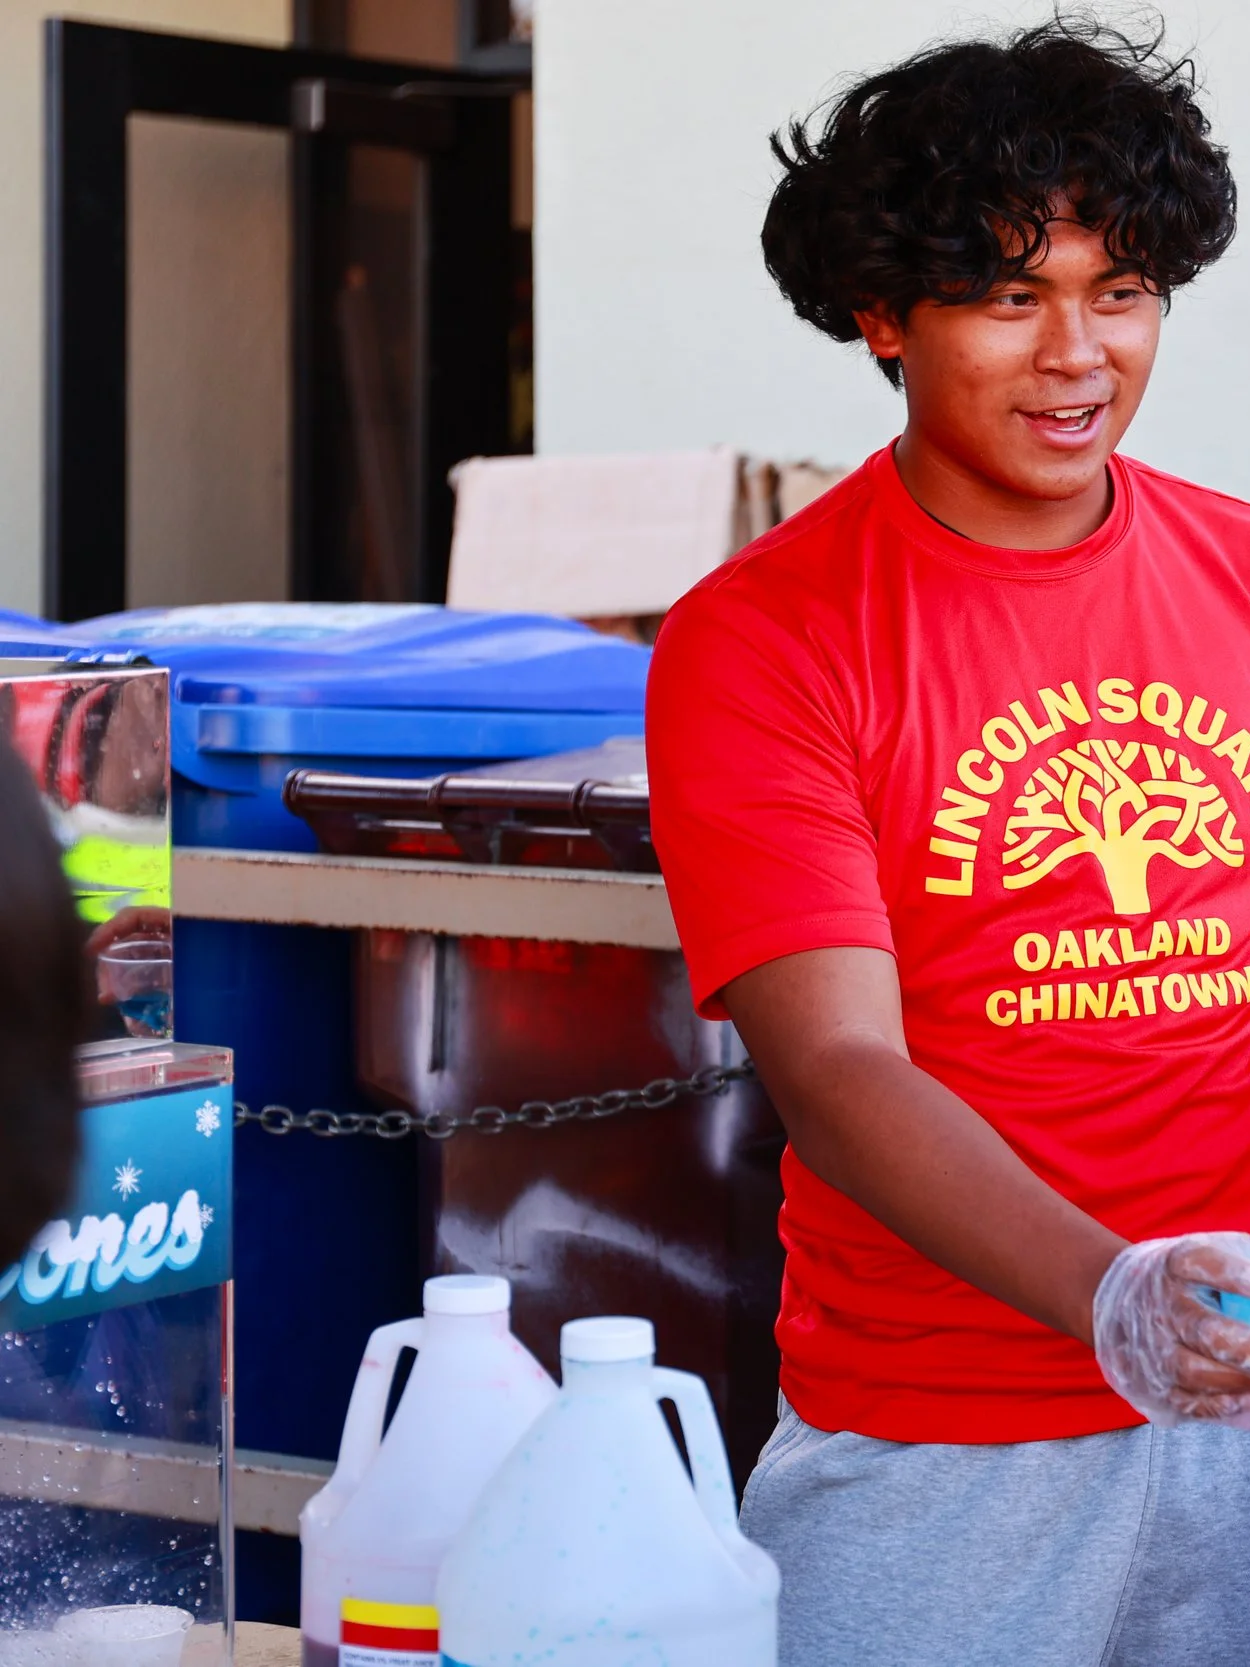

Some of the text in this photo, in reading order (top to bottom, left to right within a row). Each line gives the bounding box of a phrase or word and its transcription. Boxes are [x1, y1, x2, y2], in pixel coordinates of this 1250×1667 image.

[925, 680, 1092, 897] LINCOLN
[1013, 917, 1231, 972] OAKLAND
[0, 1189, 203, 1304] ones
